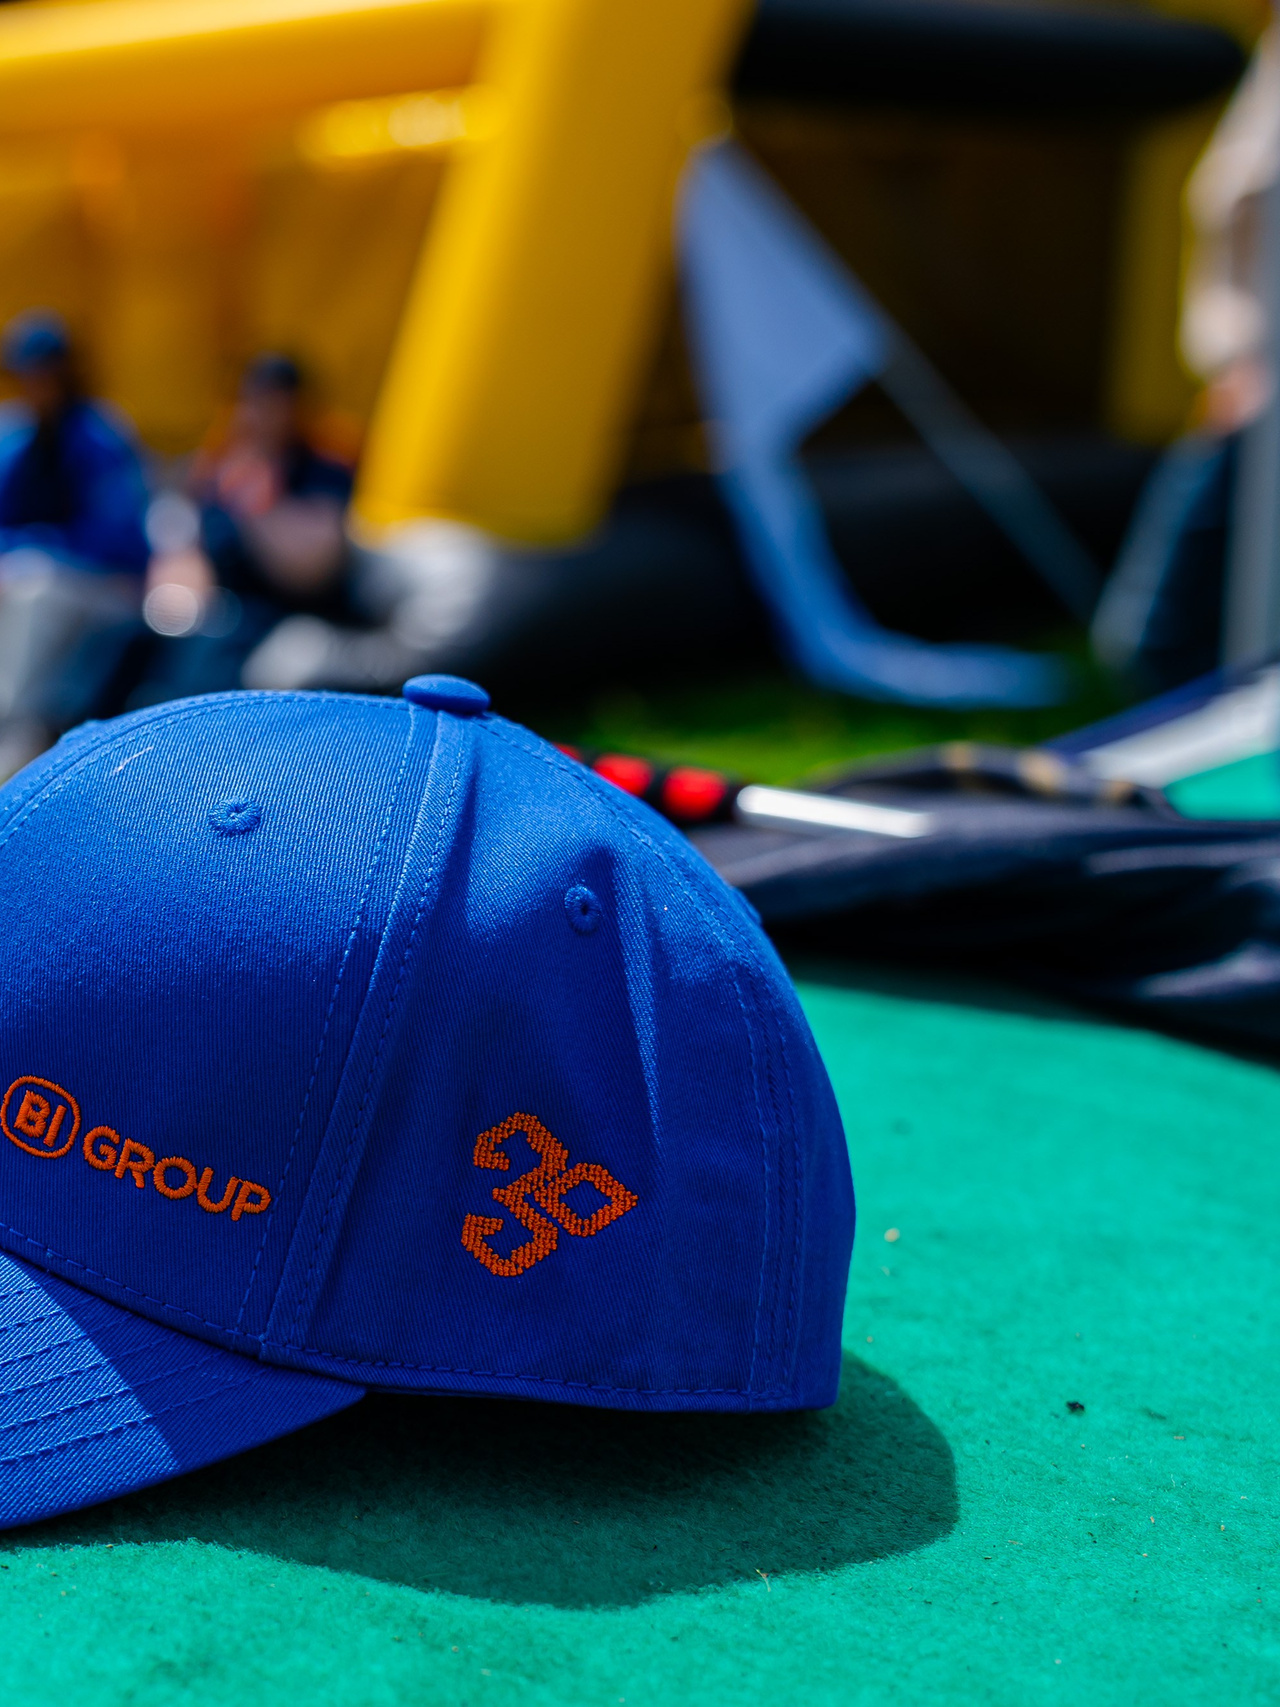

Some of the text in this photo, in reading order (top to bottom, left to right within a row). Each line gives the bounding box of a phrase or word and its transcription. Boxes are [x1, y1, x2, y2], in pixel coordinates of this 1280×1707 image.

[11, 1087, 271, 1222] BI GROUP
[461, 1112, 639, 1277] 30
